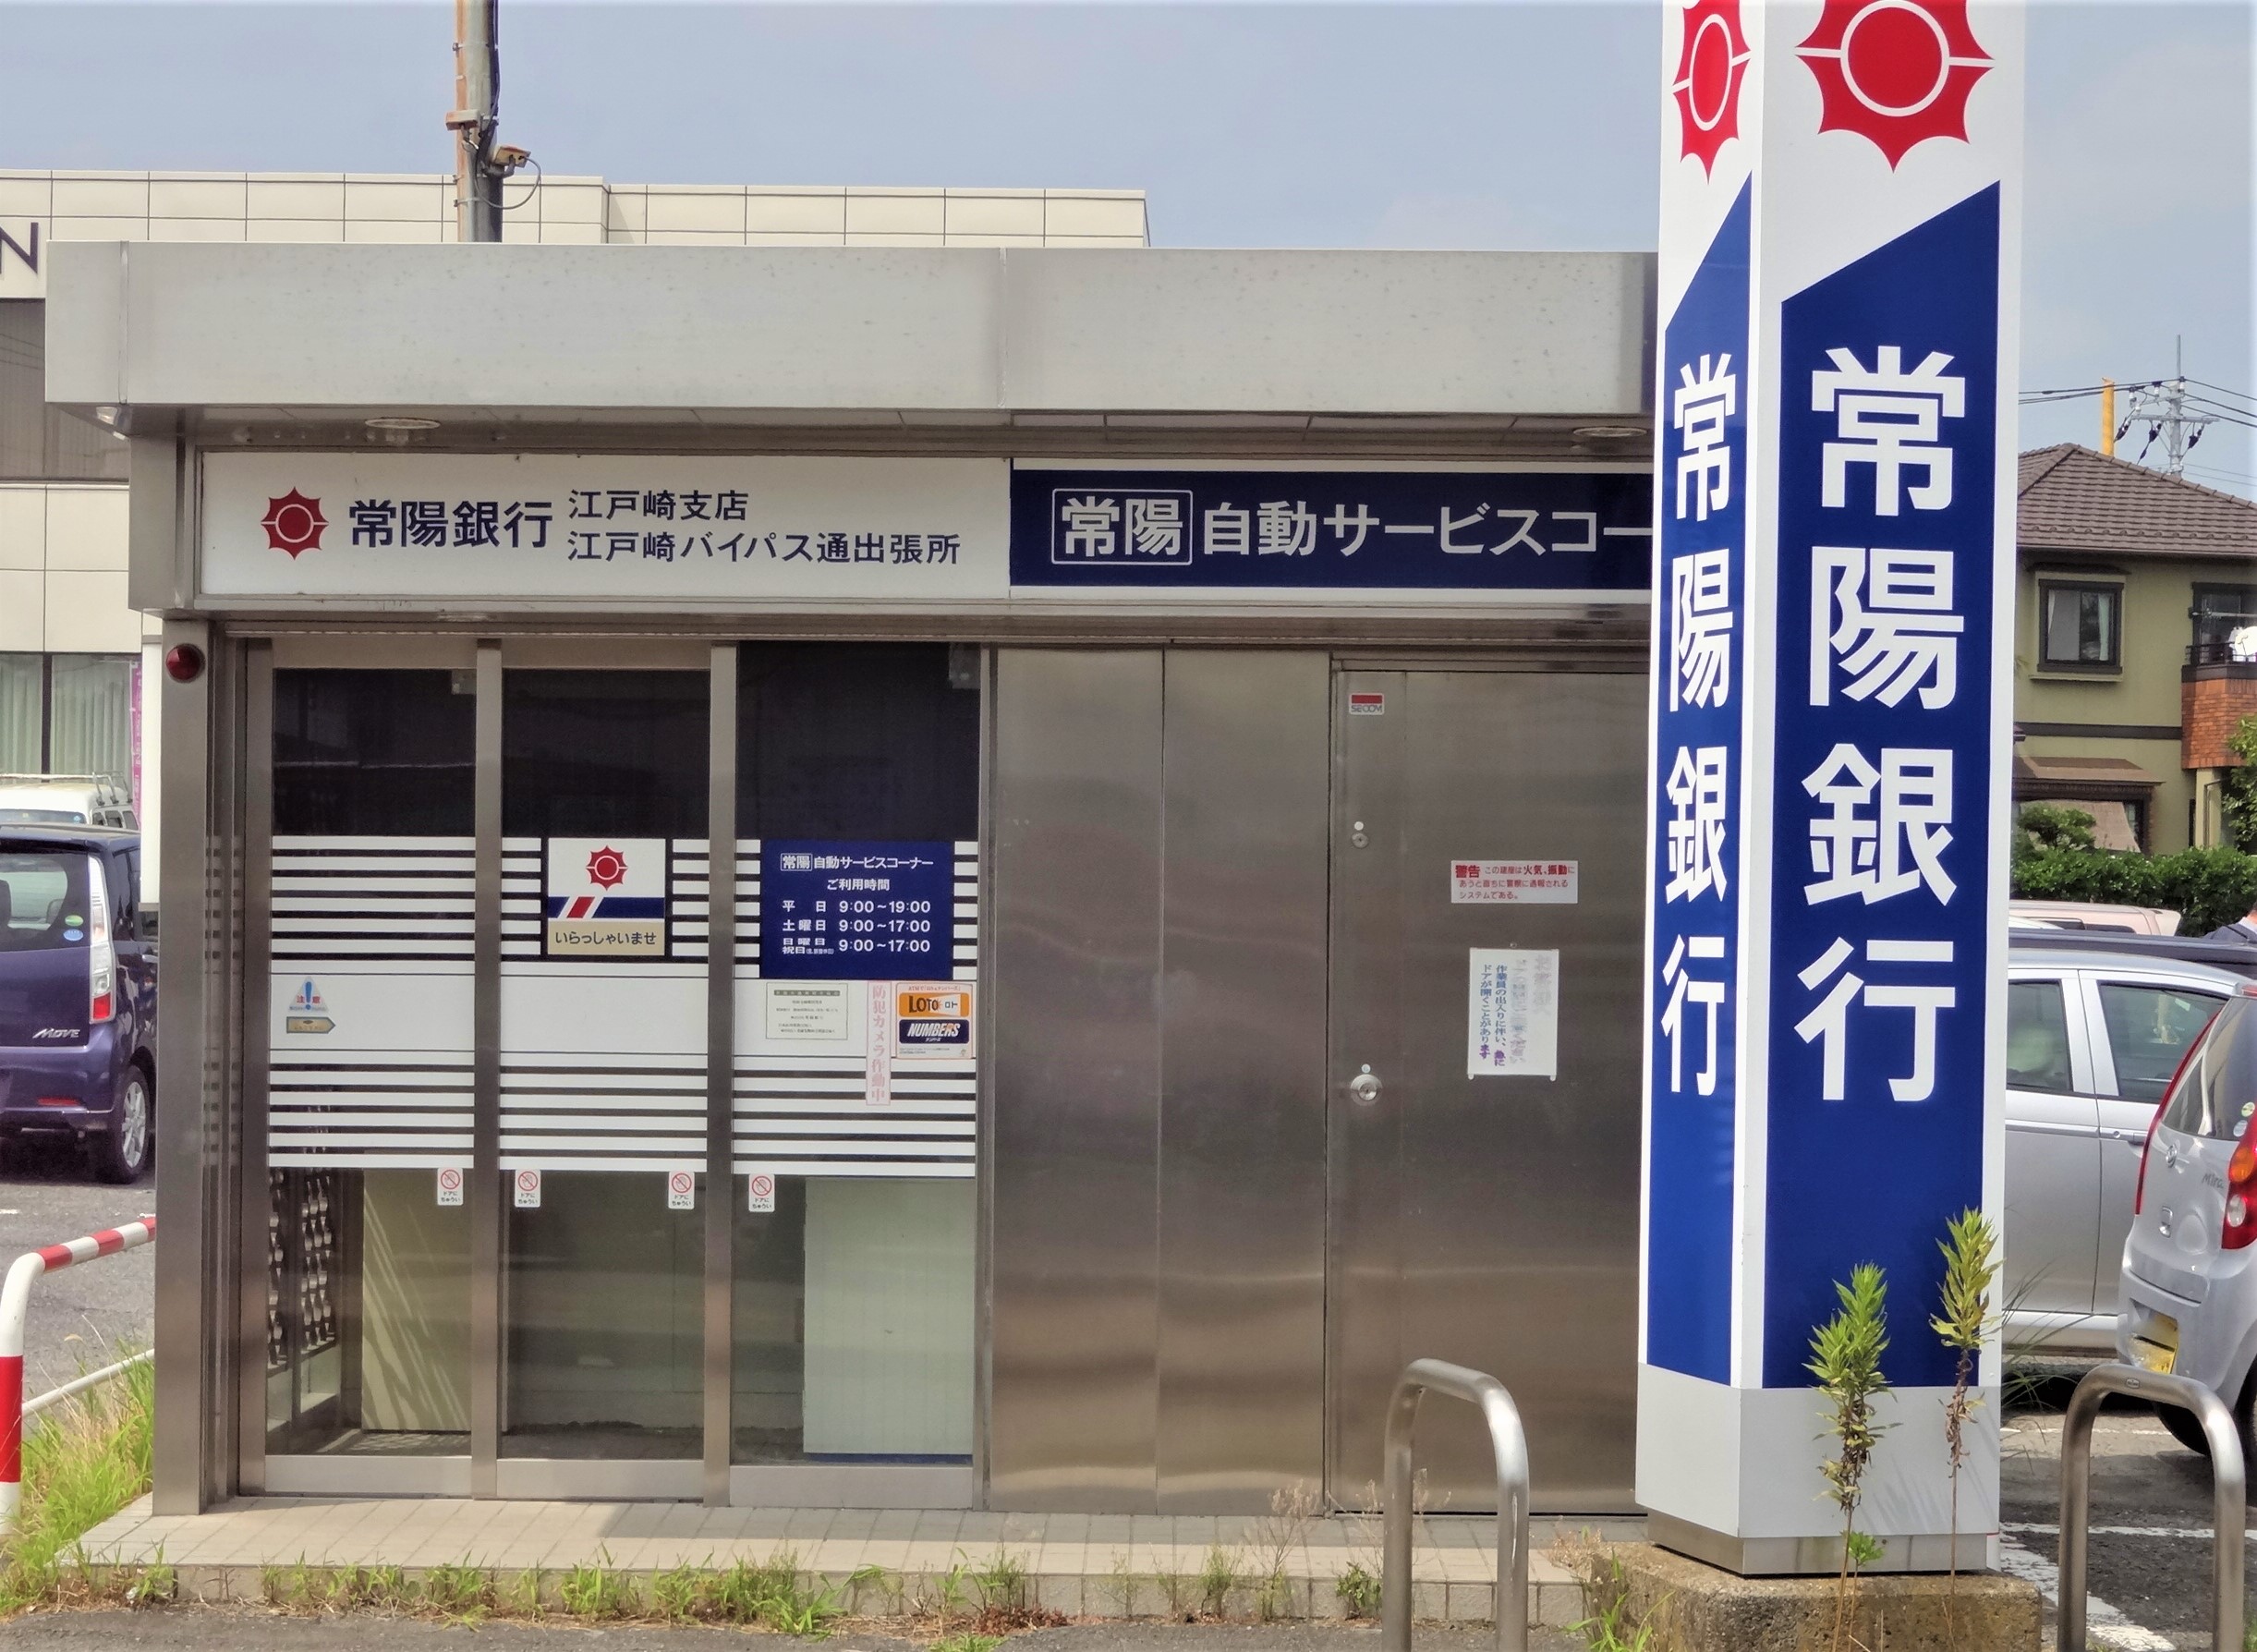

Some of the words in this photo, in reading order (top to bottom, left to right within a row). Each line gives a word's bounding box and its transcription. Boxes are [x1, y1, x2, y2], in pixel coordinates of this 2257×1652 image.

[567, 489, 749, 521] 江戸崎支店
[348, 499, 553, 549] 常陽銀行
[1061, 495, 1183, 558] 常陽
[566, 530, 962, 565] 江戸崎バイパス通出張所
[1351, 704, 1383, 713] SECOM
[1660, 352, 1737, 1098] 常陽銀行
[1794, 345, 1966, 1102] 常陽銀行
[783, 855, 811, 870] 常陽
[813, 855, 934, 870] 自動サービスコーナー
[1455, 865, 1481, 879] 警告
[827, 879, 891, 892] ご利用時間
[555, 931, 657, 945] いらっしゃいませ
[908, 995, 940, 1014] LOTO
[32, 1028, 81, 1039] MOVE
[907, 1023, 961, 1038] NUMBERS
